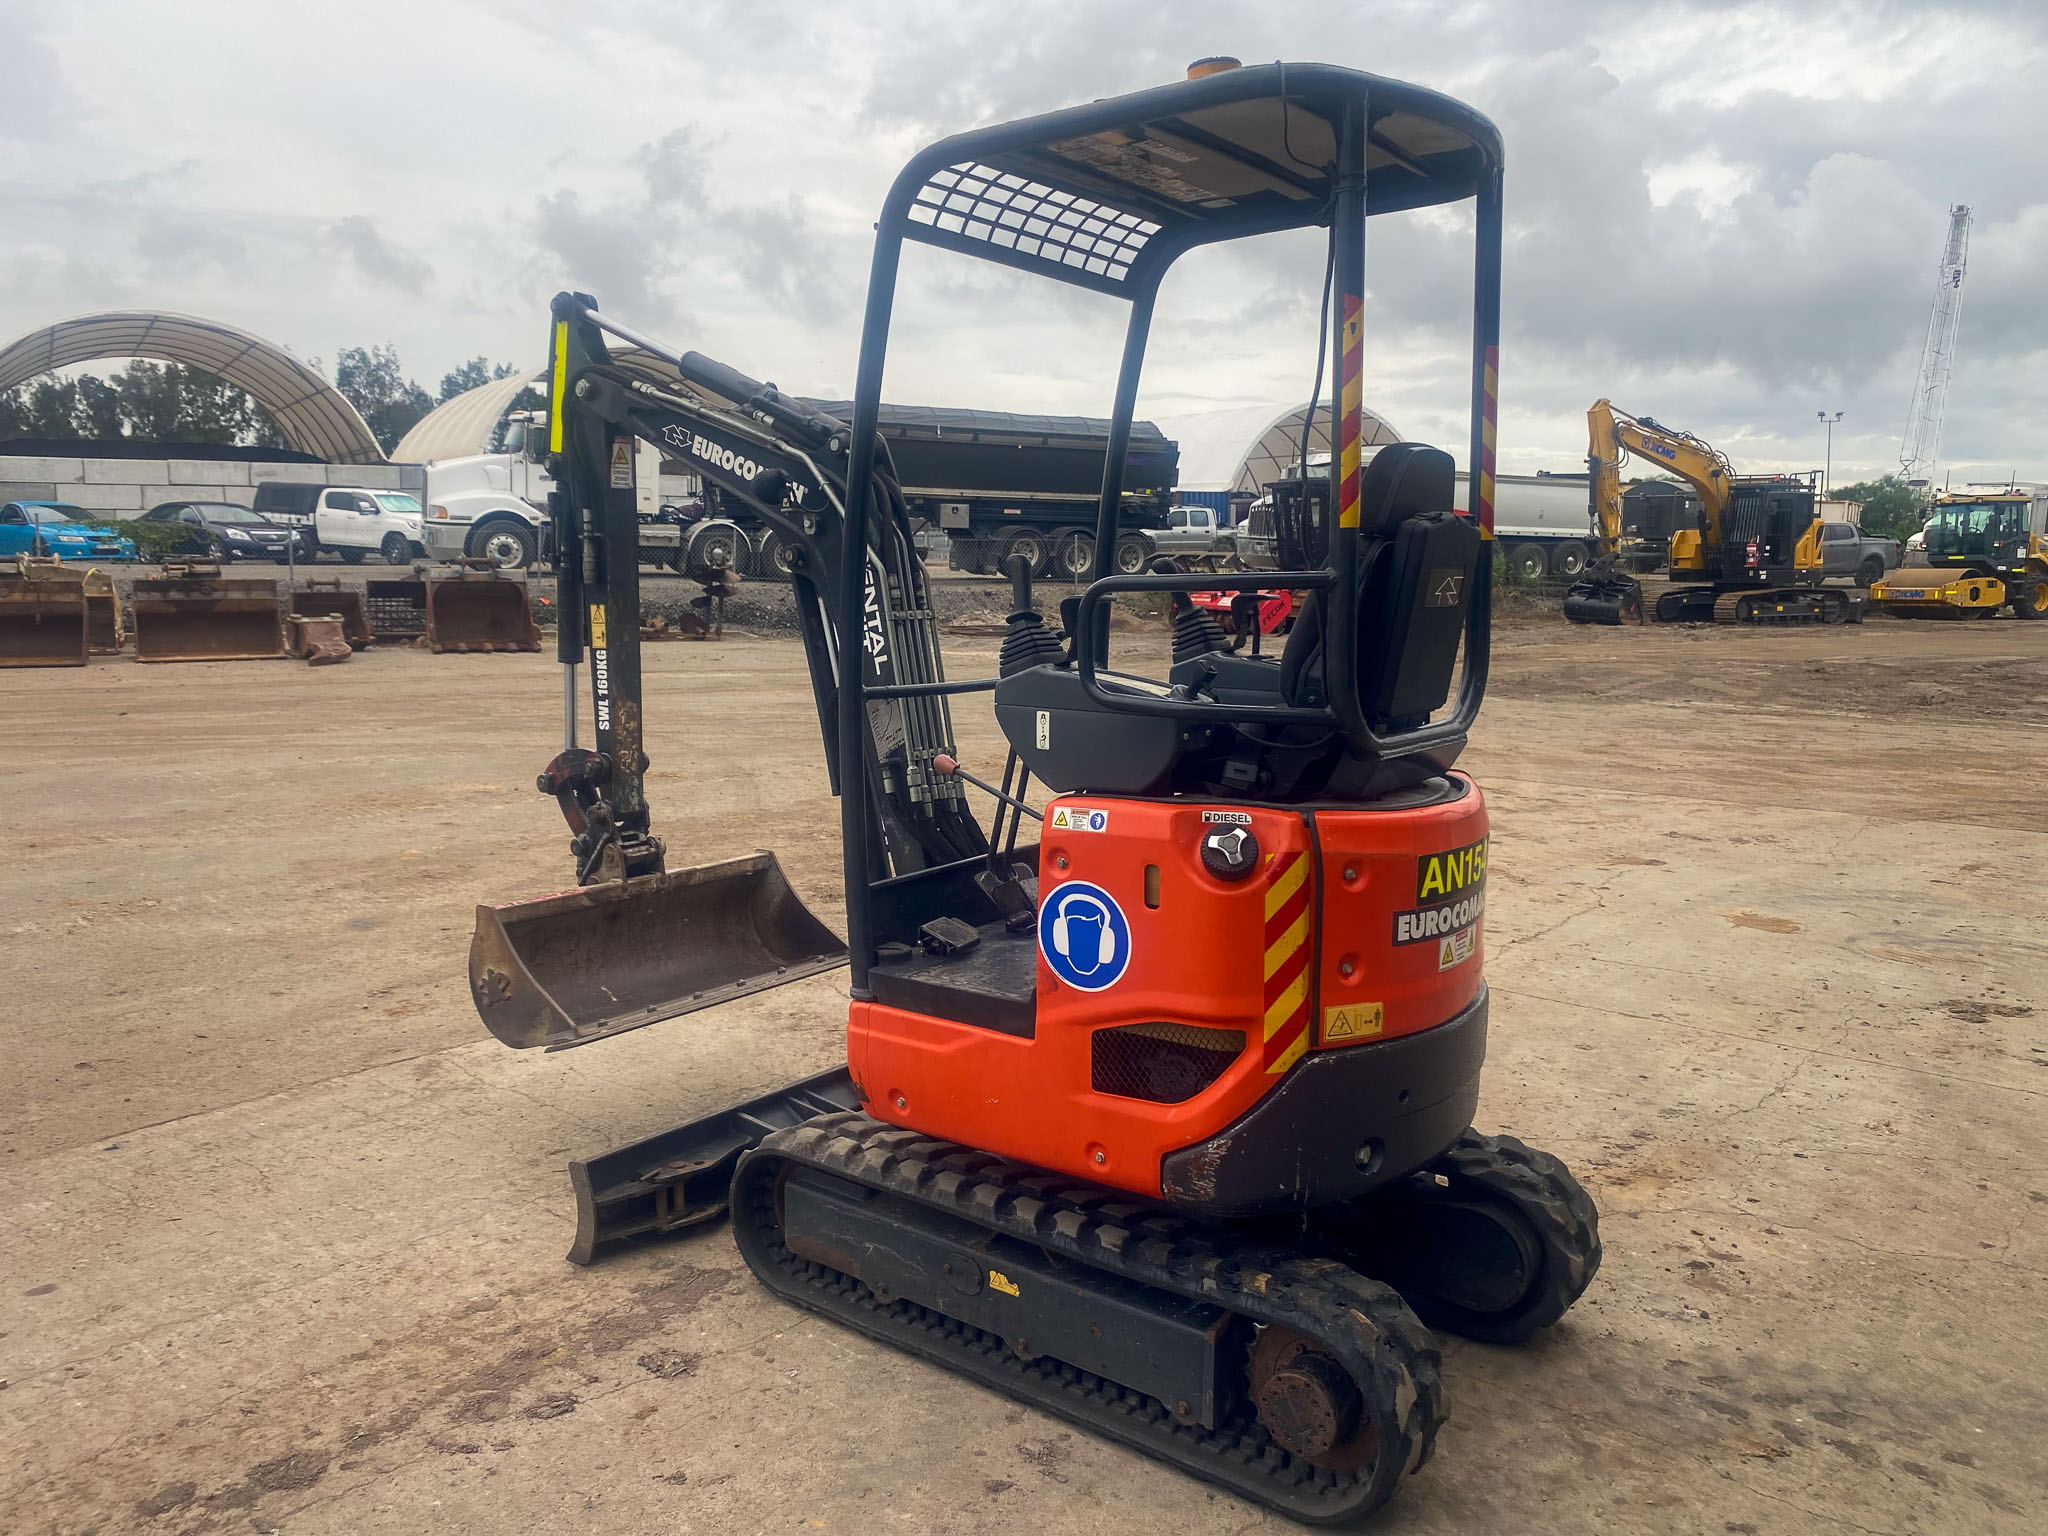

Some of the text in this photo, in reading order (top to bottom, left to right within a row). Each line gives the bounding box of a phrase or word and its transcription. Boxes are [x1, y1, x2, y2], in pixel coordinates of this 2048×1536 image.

[864, 553, 888, 675] ENTAL
[595, 649, 610, 731] SWL 160KG
[1213, 813, 1251, 823] DIESEL
